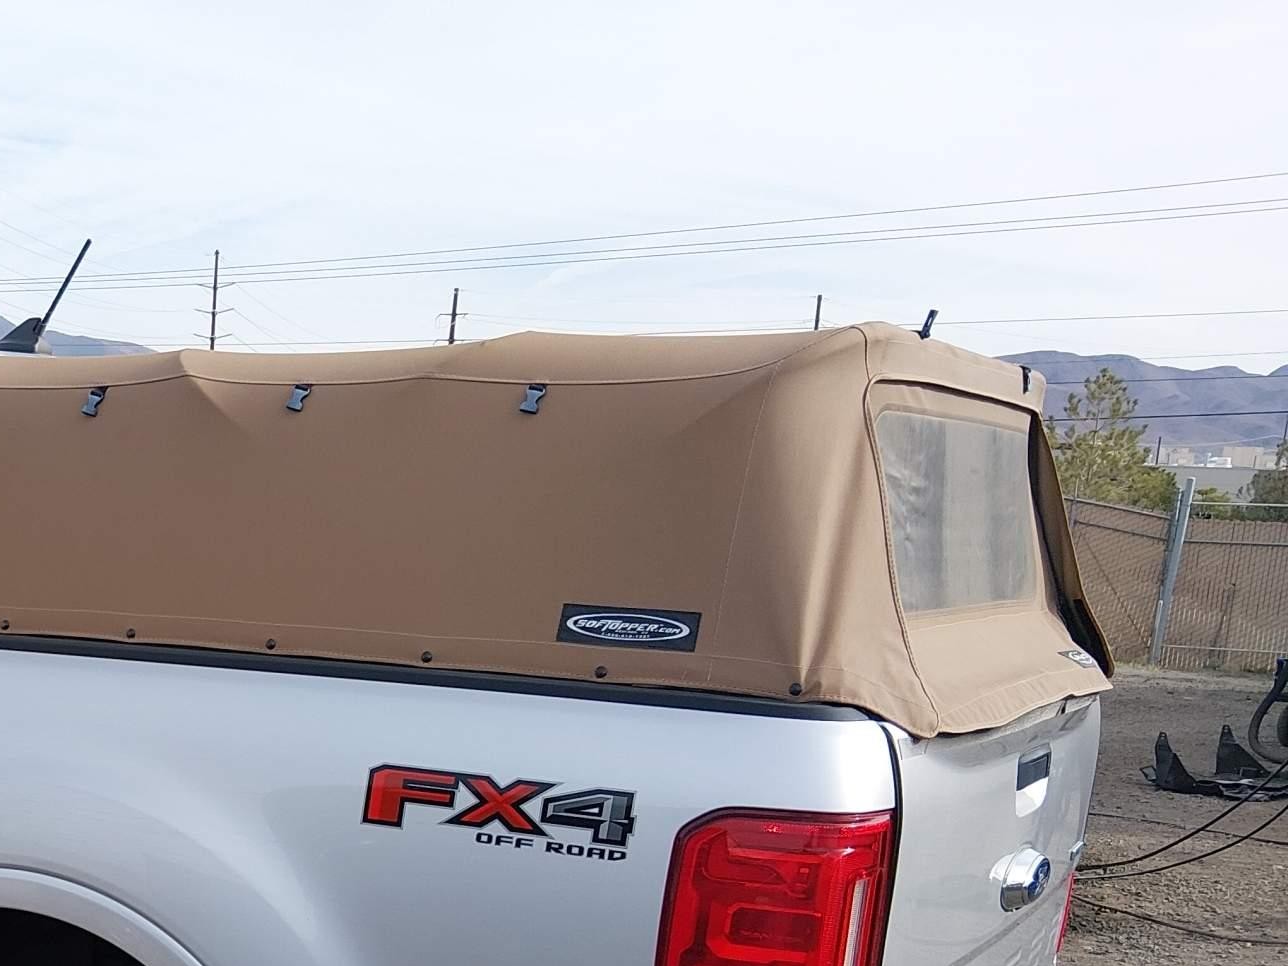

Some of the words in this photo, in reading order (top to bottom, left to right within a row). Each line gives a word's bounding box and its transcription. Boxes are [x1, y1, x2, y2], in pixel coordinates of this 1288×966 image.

[361, 764, 637, 848] FX4
[475, 832, 534, 849] OFF
[545, 840, 627, 861] ROAD
